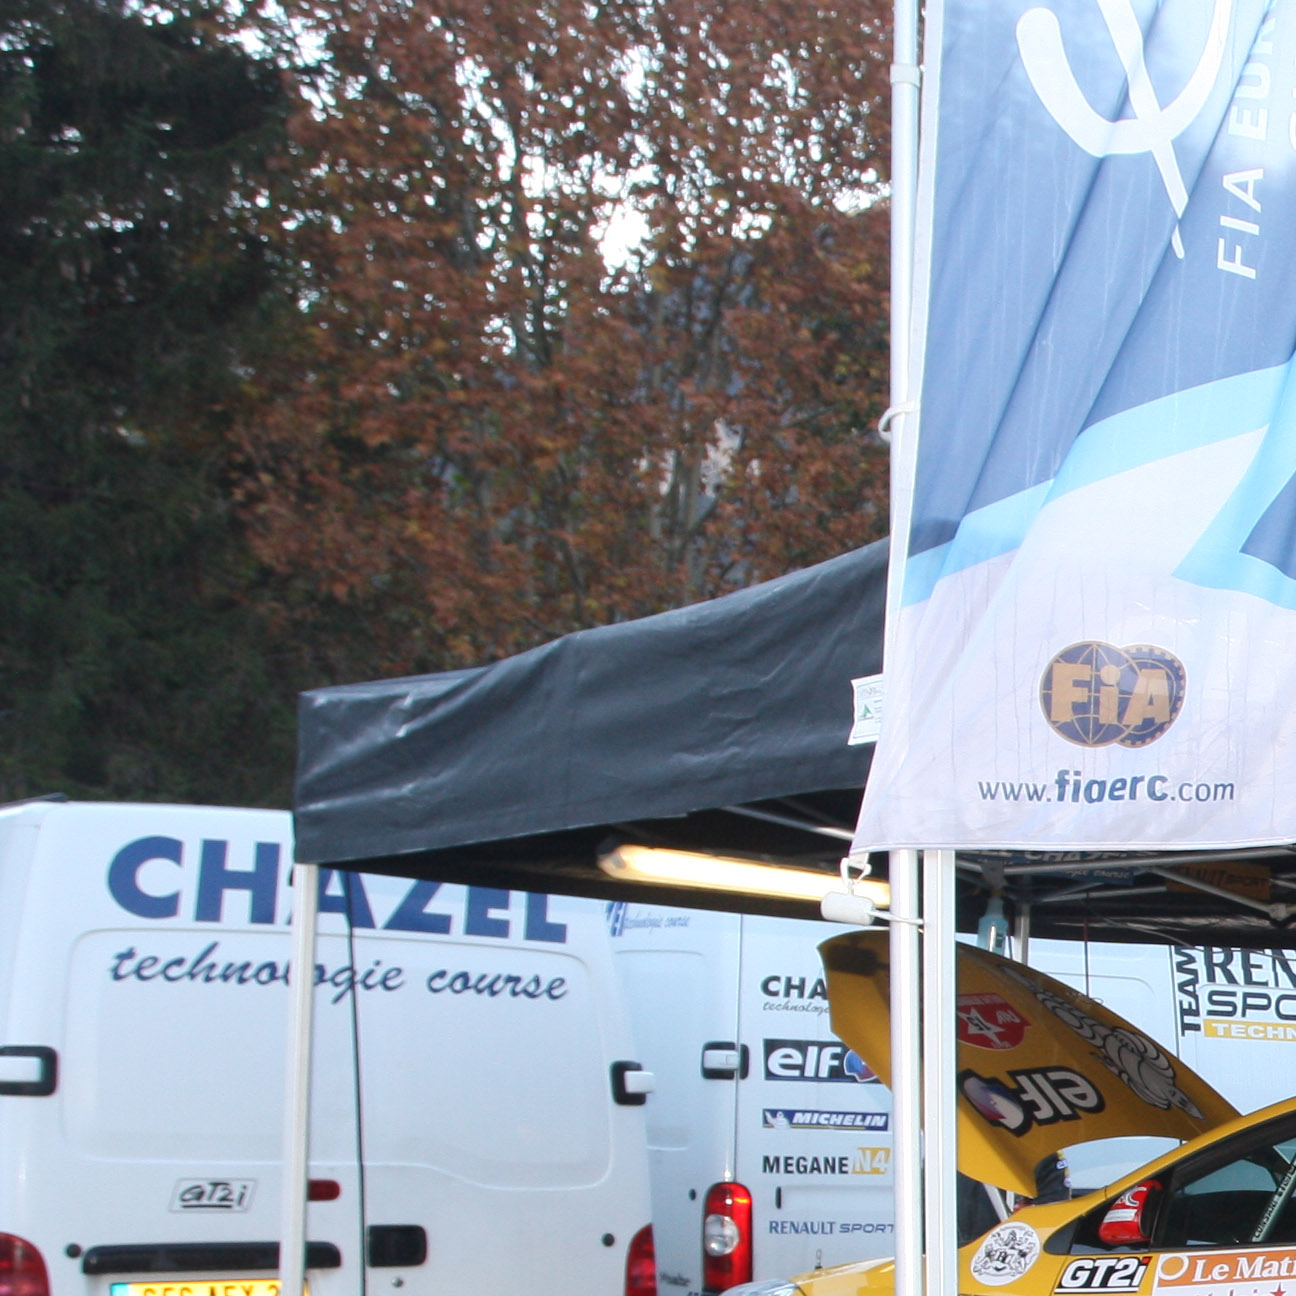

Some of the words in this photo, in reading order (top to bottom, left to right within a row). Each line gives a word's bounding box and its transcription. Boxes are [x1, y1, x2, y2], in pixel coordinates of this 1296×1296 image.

[1217, 167, 1264, 280] FIA
[978, 769, 1235, 804] www.fiaerc.com
[109, 942, 404, 1004] technoogie
[427, 969, 568, 1000] course
[760, 974, 828, 1000] CHA
[1174, 946, 1201, 1037] TEAM
[767, 1048, 843, 1079] elf
[1016, 1070, 1098, 1121] elf
[792, 1111, 887, 1128] MICHELIN
[762, 1155, 849, 1175] MEGANE
[854, 1148, 889, 1174] N4
[768, 1219, 835, 1236] RENAULT
[838, 1222, 894, 1235] SPORT
[1061, 1256, 1151, 1289] GT2i
[1193, 1261, 1230, 1282] Le
